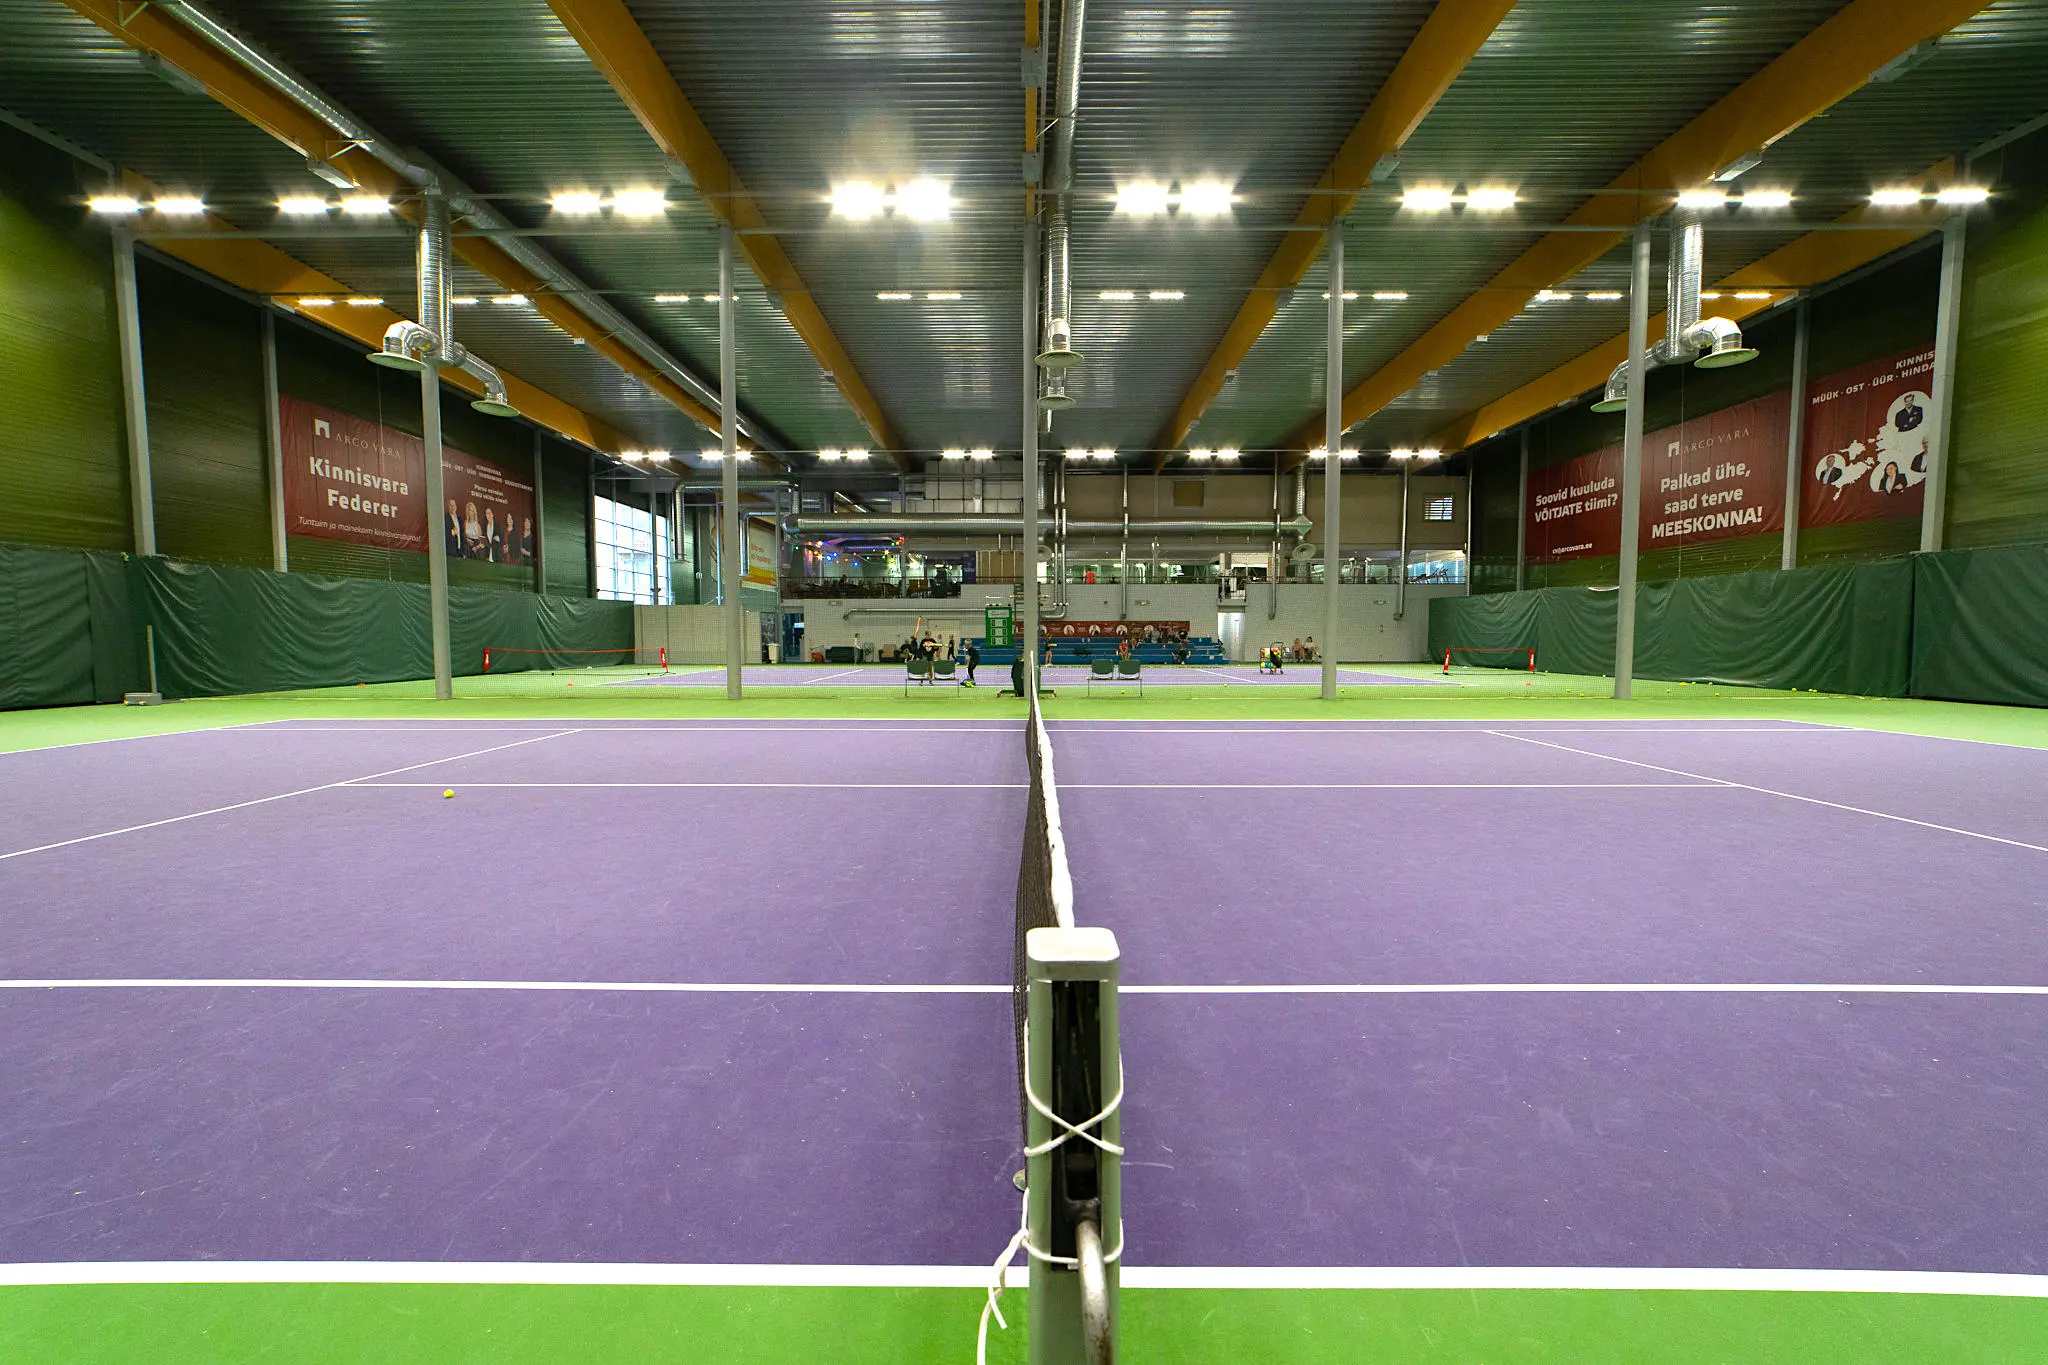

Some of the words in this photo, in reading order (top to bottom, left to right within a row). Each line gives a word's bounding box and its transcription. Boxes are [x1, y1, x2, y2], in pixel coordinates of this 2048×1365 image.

[1896, 350, 1935, 370] KINNIS
[1812, 390, 1839, 404] MÜÜK
[1846, 382, 1865, 395] OST
[1872, 374, 1894, 387] ÜÜR
[1901, 361, 1935, 378] HINDA
[335, 433, 368, 449] ARCO
[1684, 438, 1714, 453] ARCO
[1718, 427, 1749, 443] VARA
[310, 456, 409, 496] Kinnisvara
[1535, 487, 1568, 506] Soovid
[1570, 476, 1615, 498] kuuluda
[1660, 467, 1711, 493] Palkad
[1715, 461, 1751, 481] ühe,
[327, 488, 398, 518] Federer
[1535, 501, 1583, 523] VÕITJATE
[1585, 493, 1618, 512] tiimi?
[1664, 494, 1698, 515] saad
[1701, 488, 1744, 508] terve
[1652, 506, 1763, 539] MEESKONNA!
[1552, 542, 1593, 554] cv@arcovara.ee
